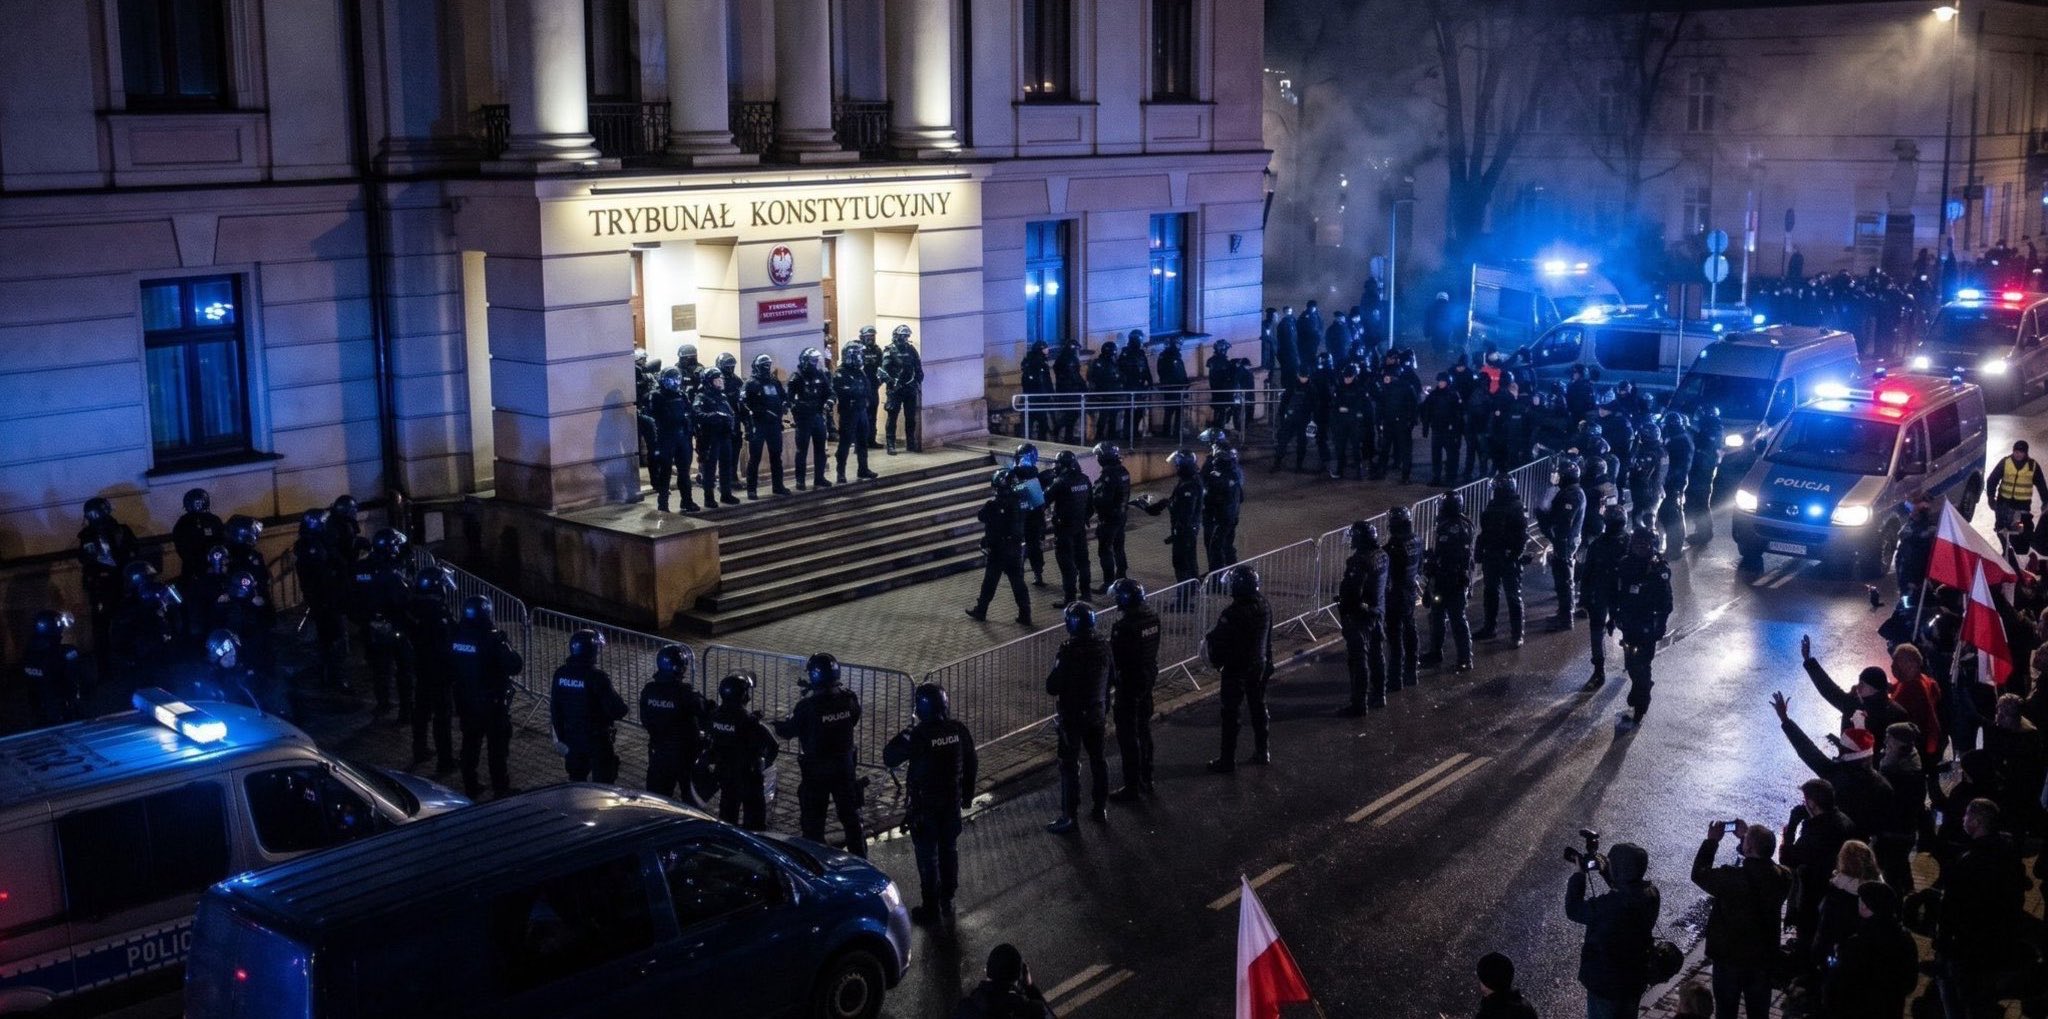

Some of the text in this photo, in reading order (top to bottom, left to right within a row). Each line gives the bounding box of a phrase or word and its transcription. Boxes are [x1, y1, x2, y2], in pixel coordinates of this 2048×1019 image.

[589, 192, 951, 236] TRYBUNAŁ KONSTYTUCYJNY
[1773, 477, 1830, 492] POLICJA
